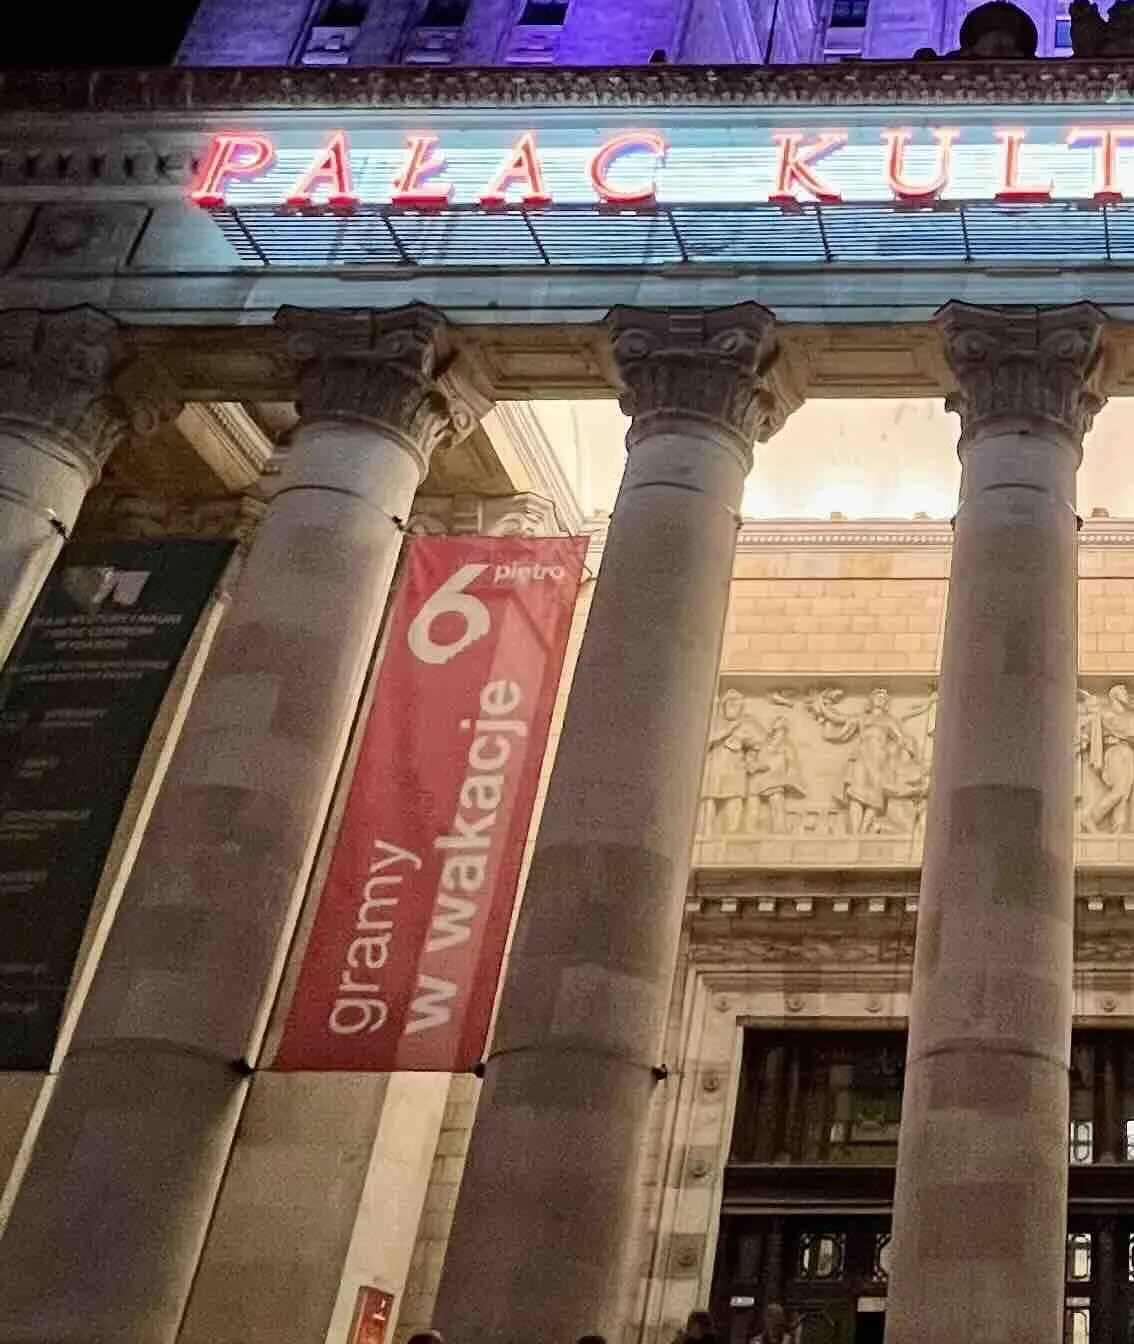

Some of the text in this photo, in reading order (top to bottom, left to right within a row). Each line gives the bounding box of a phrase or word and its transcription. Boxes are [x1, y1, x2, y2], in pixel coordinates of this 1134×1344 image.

[192, 128, 665, 207] PAŁAC
[407, 563, 491, 664] 6
[405, 678, 528, 1035] w wakacje
[328, 839, 423, 1035] gramy
